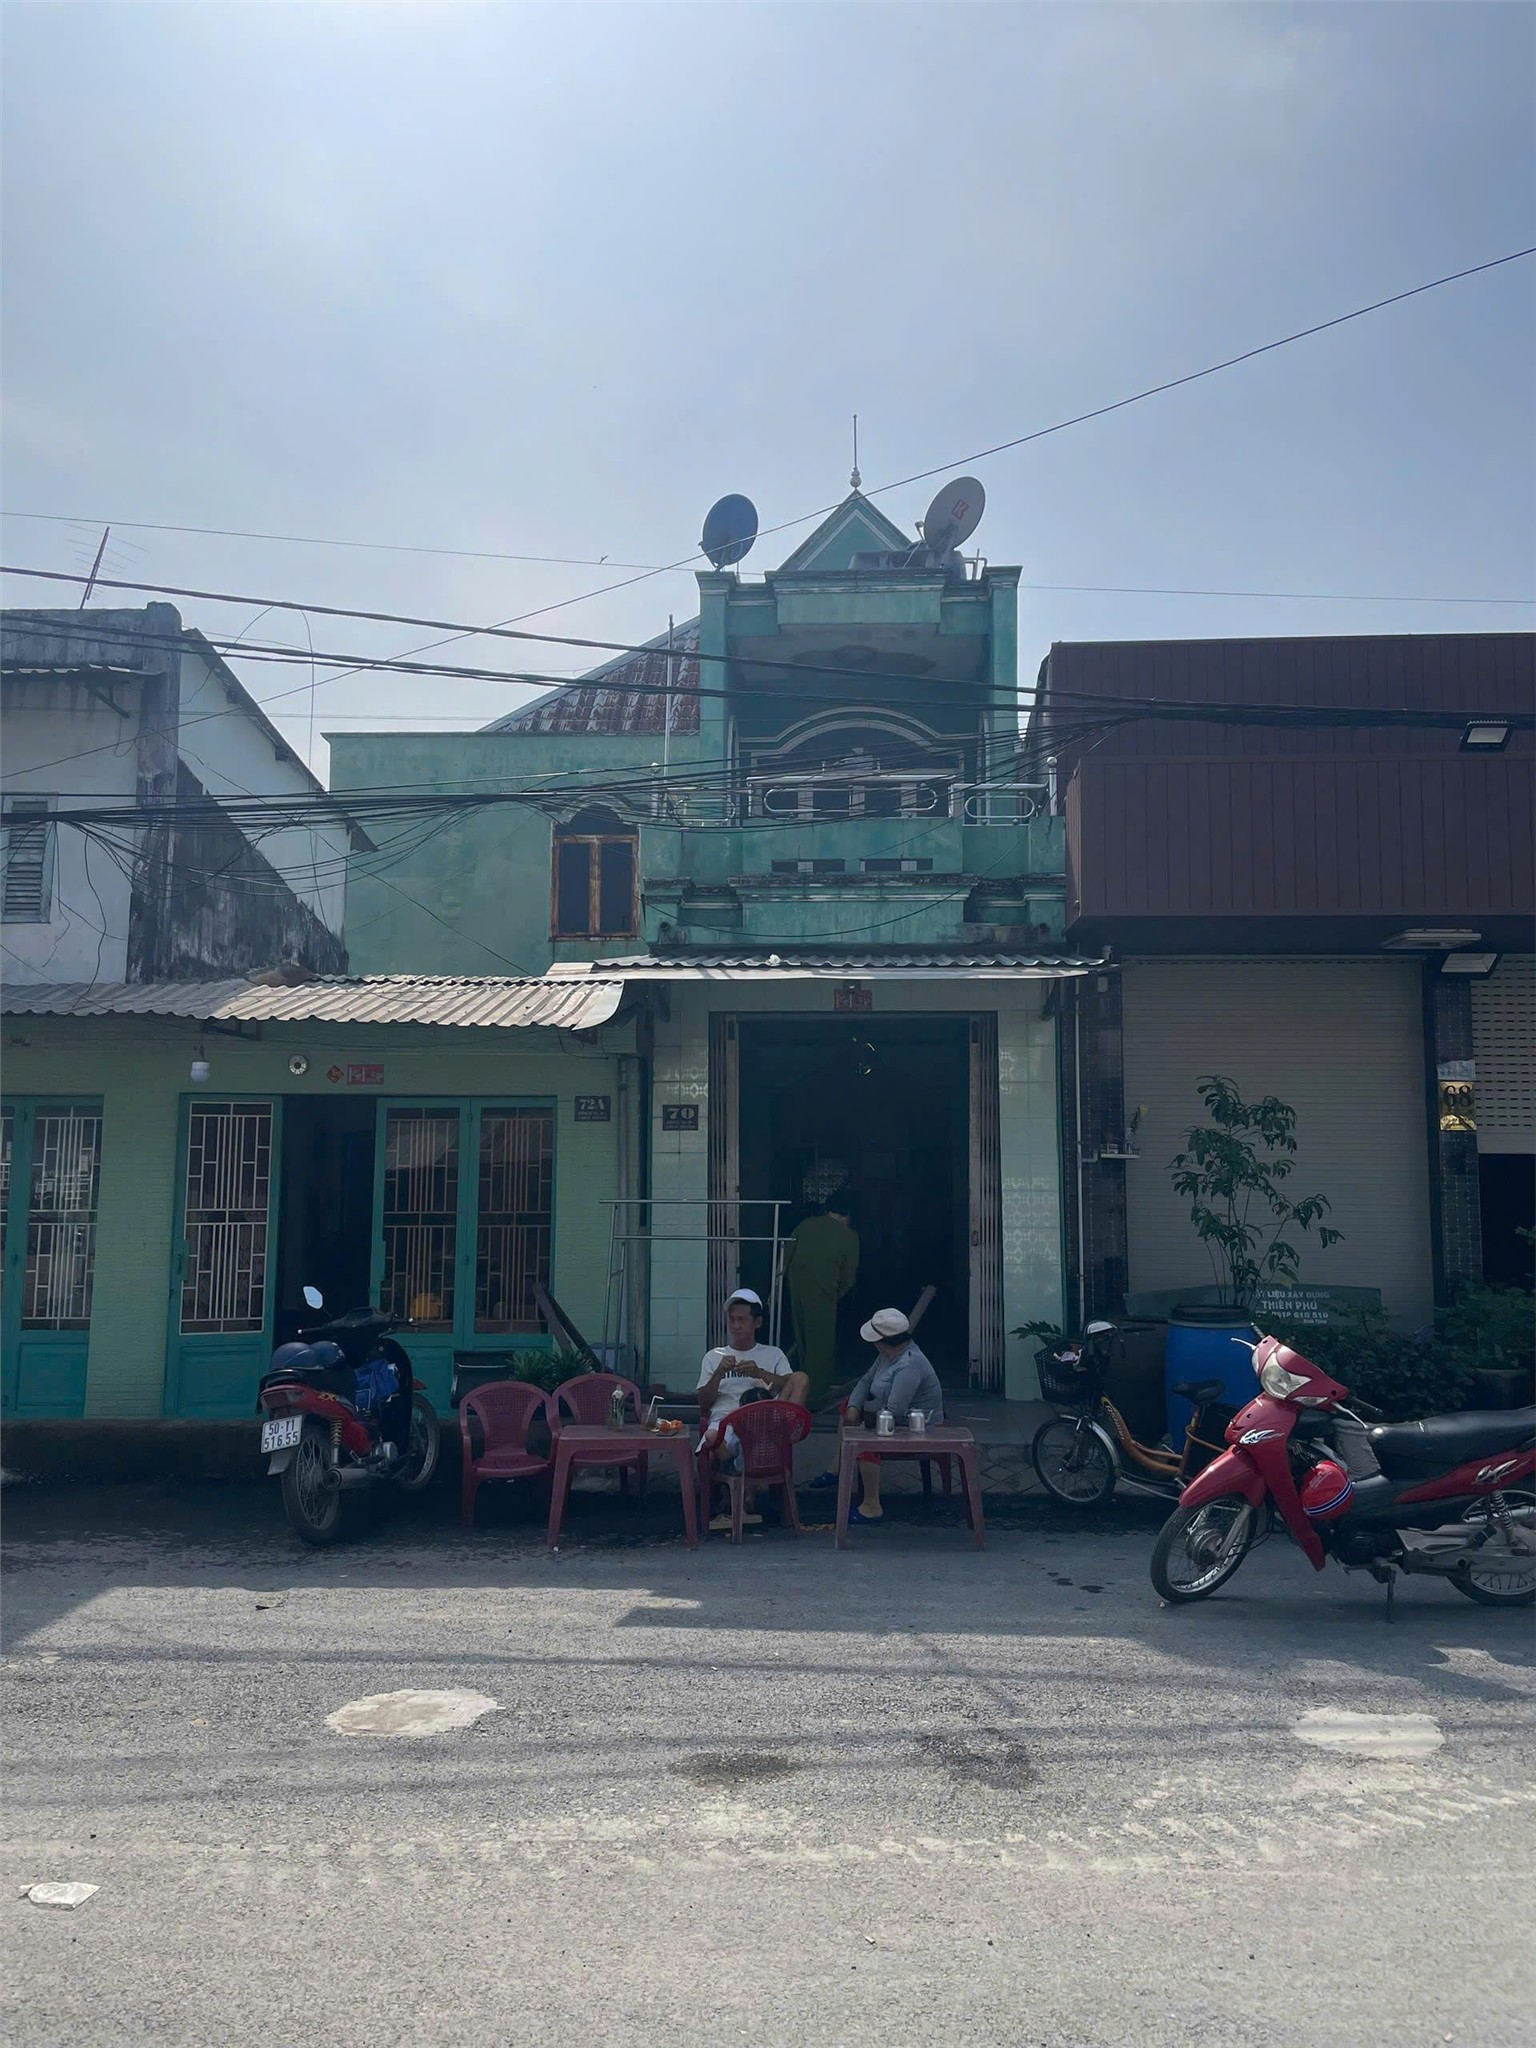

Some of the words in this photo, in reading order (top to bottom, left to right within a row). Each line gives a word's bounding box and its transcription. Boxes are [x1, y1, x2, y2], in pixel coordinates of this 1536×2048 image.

[1443, 1084, 1472, 1107] 68
[579, 1098, 605, 1110] 72A
[667, 1107, 695, 1120] 70
[1312, 1311, 1329, 1319] 510
[264, 1430, 299, 1450] 516.55
